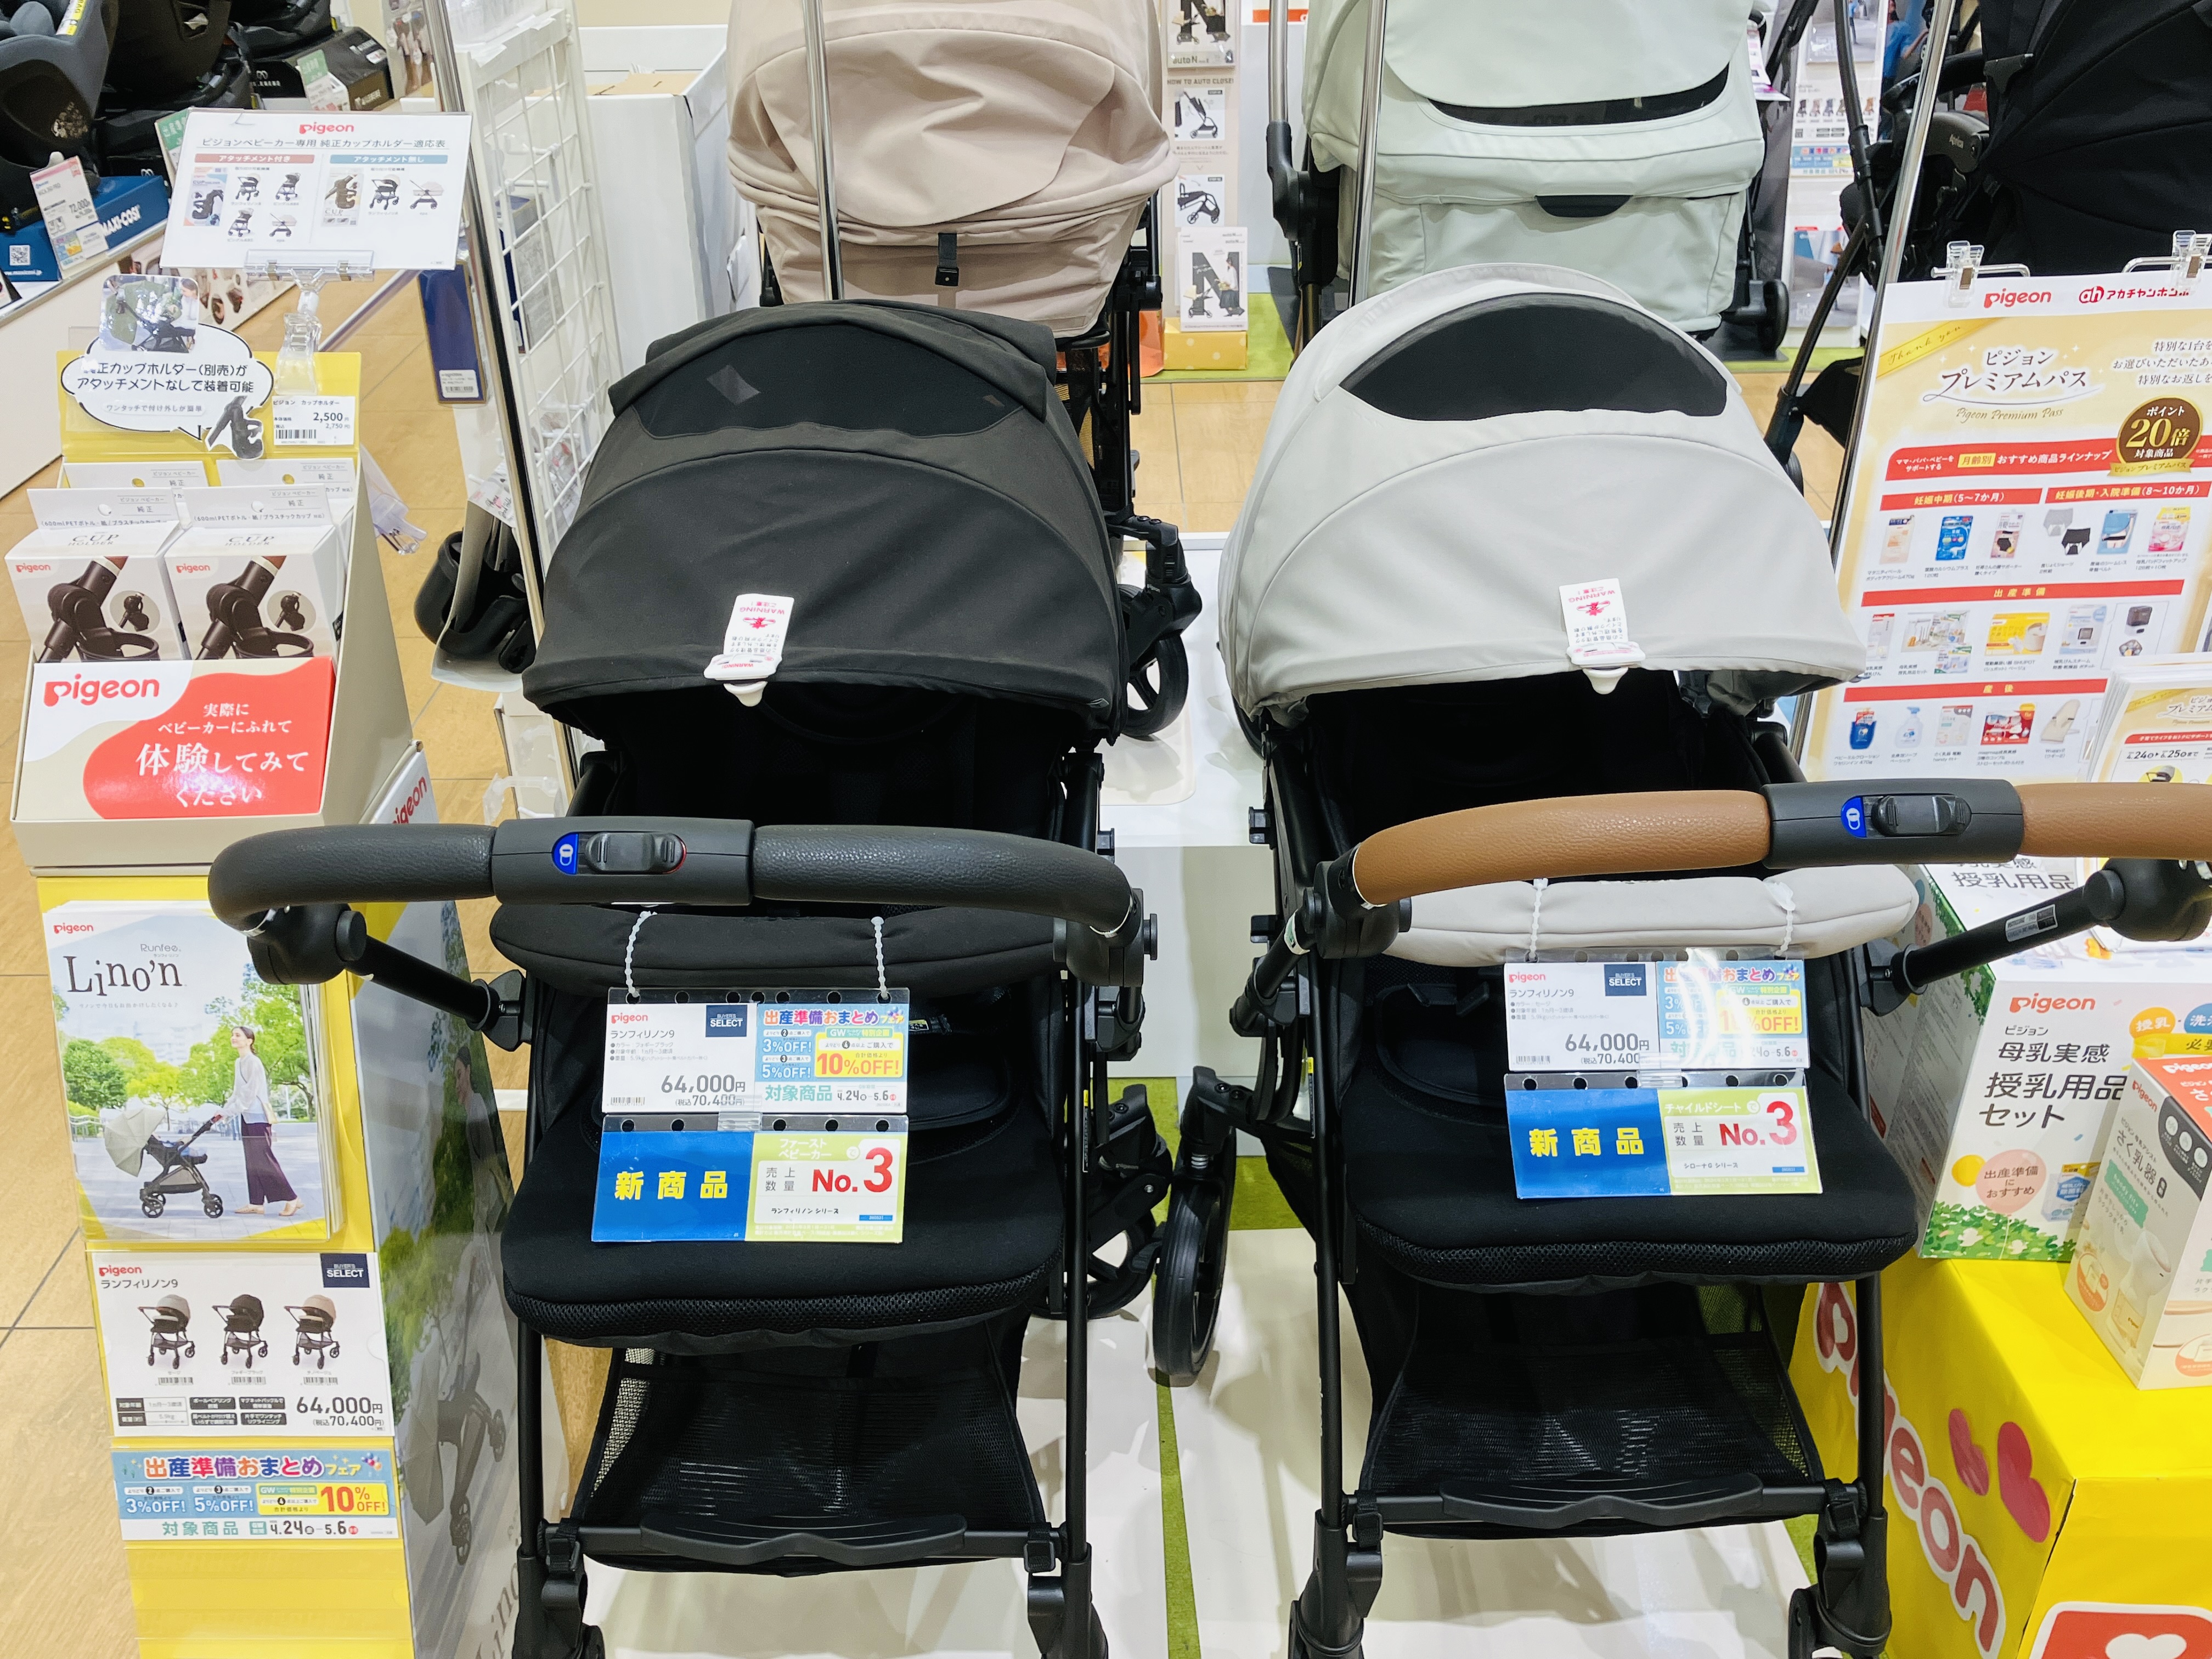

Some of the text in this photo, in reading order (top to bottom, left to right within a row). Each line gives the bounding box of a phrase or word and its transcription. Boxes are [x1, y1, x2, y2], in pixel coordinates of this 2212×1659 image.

[299, 123, 354, 134] pigeon
[202, 138, 445, 148] ピジョンベビーカー専用 純正カップホルダー適応表
[354, 155, 424, 163] アタッチメント無し
[1984, 288, 2051, 308] pigeon
[1987, 348, 2053, 366] ピジョン
[77, 377, 255, 393] アタッチメントなしで装着可能
[1941, 368, 2086, 395] プレミアムパス
[1956, 407, 2064, 424] Pigeon Premium Pass
[2146, 406, 2185, 417] ポイント
[2126, 418, 2191, 448] 20倍
[1961, 450, 2113, 466] 月齢別 おすすめ商品ラインナップ
[2134, 449, 2174, 459] 対象商品
[15, 562, 51, 573] pigeon
[176, 562, 210, 573] pigeon
[1568, 590, 1615, 602] WARNING
[1994, 586, 2046, 598] 出産準備
[740, 607, 785, 615] WARNING
[43, 673, 160, 707] pigeon
[203, 703, 249, 718] 実際に
[158, 720, 292, 735] ベビーカーにふれて
[136, 743, 309, 776] 体験してみて
[176, 786, 263, 808] ください
[392, 776, 428, 823] igeon
[1952, 871, 2075, 890] 授乳用品
[54, 922, 94, 934] pigeon
[140, 944, 178, 952] Runfee
[1509, 972, 1546, 983] pigeon
[1609, 978, 1642, 986] SELECT
[1509, 989, 1575, 997] ランフィリノン9
[2009, 992, 2096, 1013] pigeon
[611, 1012, 648, 1024] pigeon
[710, 1019, 743, 1027] SELECT
[2136, 1017, 2171, 1032] 授乳
[611, 1030, 675, 1039] ランフィリノン9
[2005, 1025, 2049, 1036] ピジョン
[763, 1039, 811, 1053] 3%OFF!
[1565, 1033, 1649, 1051] 64,000円
[1999, 1042, 2109, 1063] 母乳実感
[763, 1053, 899, 1078] 5%OFF! 10%OFF!
[661, 1075, 746, 1093] 64,000円
[1984, 1072, 2128, 1100] 授乳用品
[765, 1085, 832, 1102] 対象商品
[2132, 1080, 2158, 1113] pigeon
[1664, 1102, 1741, 1114] チャイルドシート
[1979, 1104, 2065, 1128] セット
[1673, 1122, 1703, 1133] 売上
[780, 1138, 827, 1148] ファースト
[1529, 1127, 1645, 1158] 新商品
[1675, 1135, 1704, 1146] 数量
[778, 1150, 832, 1160] ベビーカー
[766, 1167, 795, 1178] 売上
[1984, 1166, 2039, 1180] 出産準備
[614, 1170, 727, 1200] 新商品
[765, 1181, 794, 1192] 数量
[1987, 1187, 2035, 1199] おすすめ
[99, 1265, 142, 1277] pigeon
[326, 1269, 364, 1278] SELECT
[101, 1279, 178, 1289] ランフィリノン9
[297, 1397, 383, 1414] 64,000円
[126, 1498, 186, 1513] 3%OFF!
[194, 1497, 254, 1512] 5%OFF!
[357, 1502, 386, 1512] OFF!
[162, 1521, 239, 1536] 対象商品
